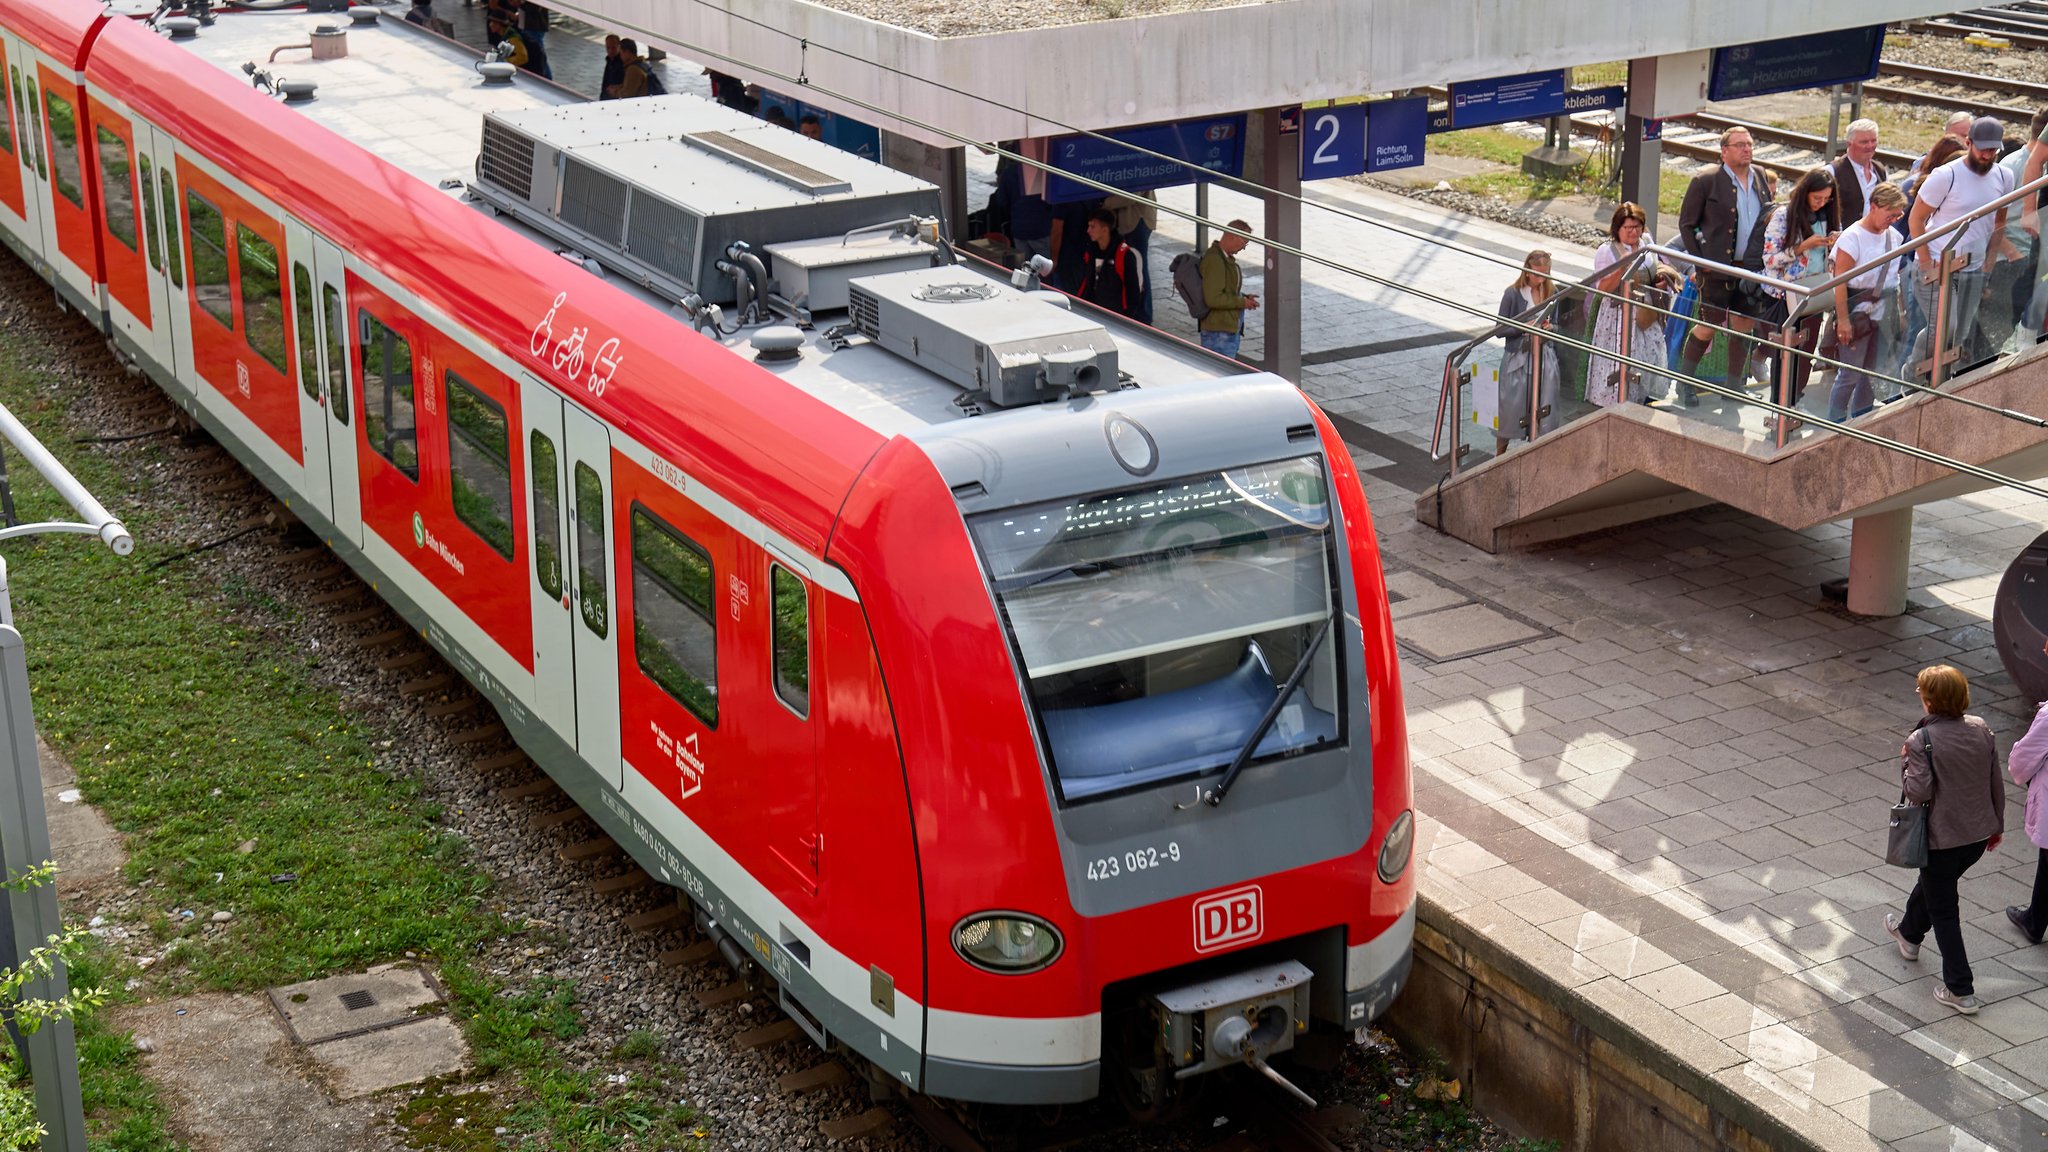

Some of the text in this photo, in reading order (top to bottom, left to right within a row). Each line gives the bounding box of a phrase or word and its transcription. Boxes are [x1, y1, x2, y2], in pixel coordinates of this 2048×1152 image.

[1752, 65, 1818, 84] Holzkirchen
[1210, 126, 1231, 140] S7
[1312, 113, 1341, 165] 2
[1066, 143, 1076, 158] 2
[1376, 144, 1408, 156] Richtung
[1376, 153, 1414, 166] Laim/Solln
[651, 455, 687, 491] 423 062-9
[425, 528, 439, 554] Bahn
[439, 541, 464, 576] München
[676, 740, 704, 775] Bahnland
[676, 754, 696, 782] Bayern
[1087, 842, 1181, 881] 423 062-9
[1202, 895, 1256, 944] DB
